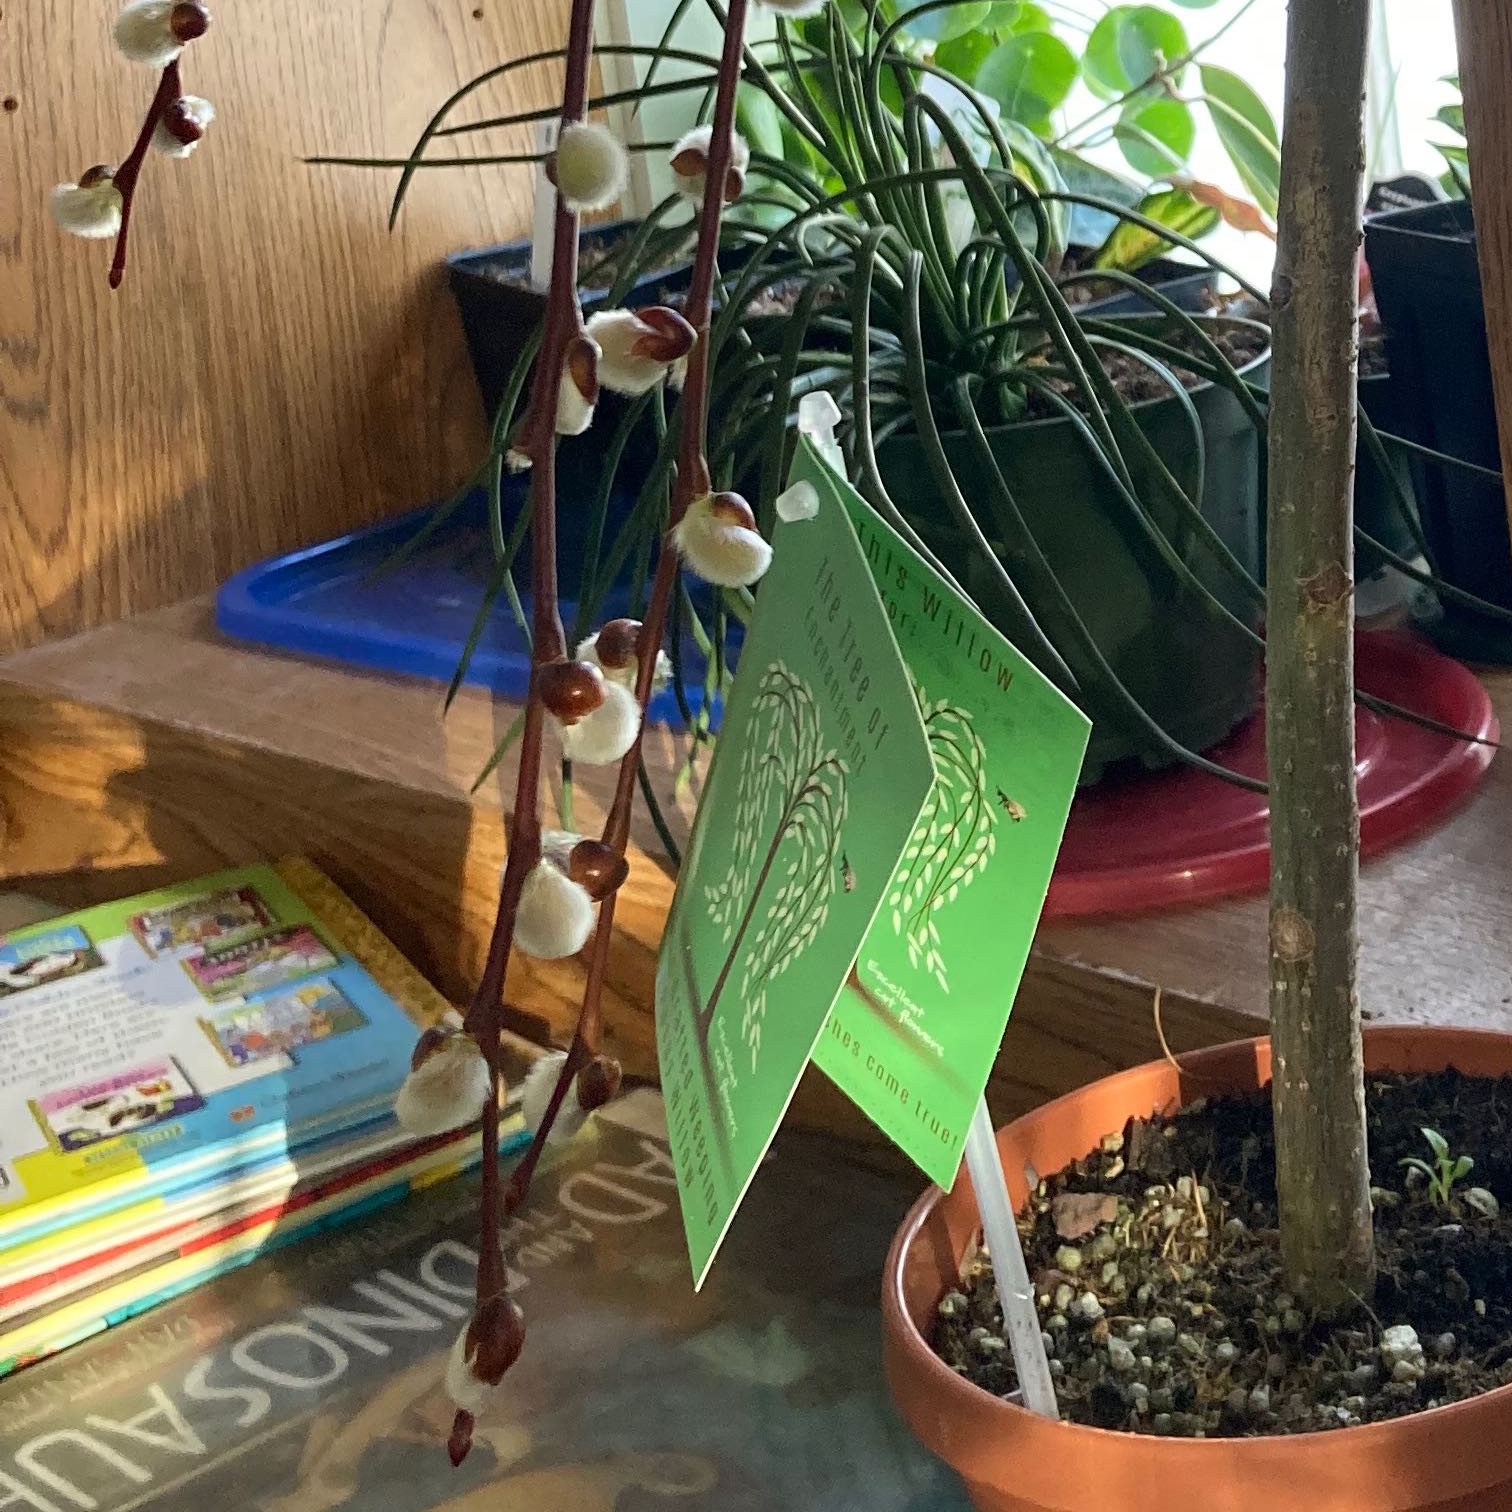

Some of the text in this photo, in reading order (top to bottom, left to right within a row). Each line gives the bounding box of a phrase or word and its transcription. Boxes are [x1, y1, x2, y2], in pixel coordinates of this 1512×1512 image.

[815, 555, 889, 751] The Tree of
[857, 521, 908, 591] This
[922, 586, 1013, 693] Willow
[866, 1055, 909, 1105] come
[915, 1100, 958, 1151] true!
